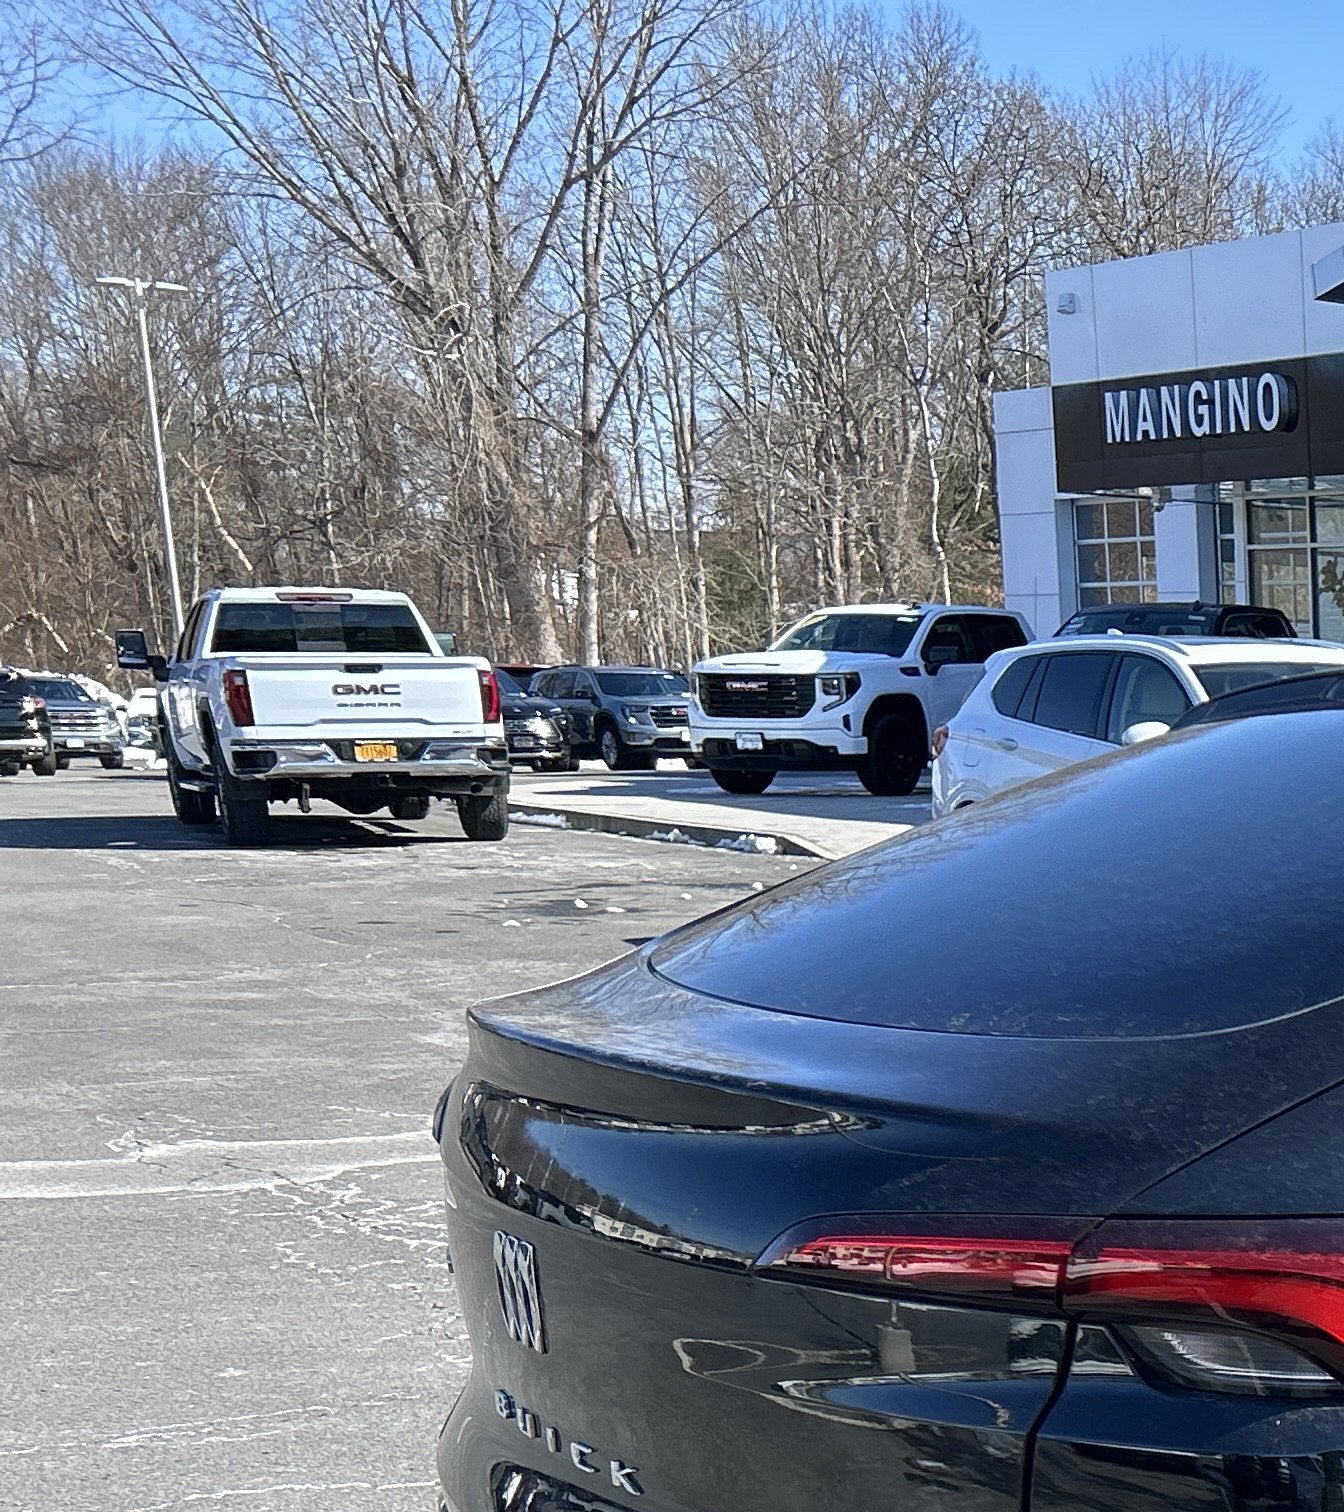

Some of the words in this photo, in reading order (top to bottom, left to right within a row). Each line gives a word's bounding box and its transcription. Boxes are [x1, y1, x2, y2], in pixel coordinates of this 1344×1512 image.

[1104, 372, 1281, 443] MANGINO
[332, 684, 402, 695] GMC
[494, 1389, 644, 1495] BUICK
